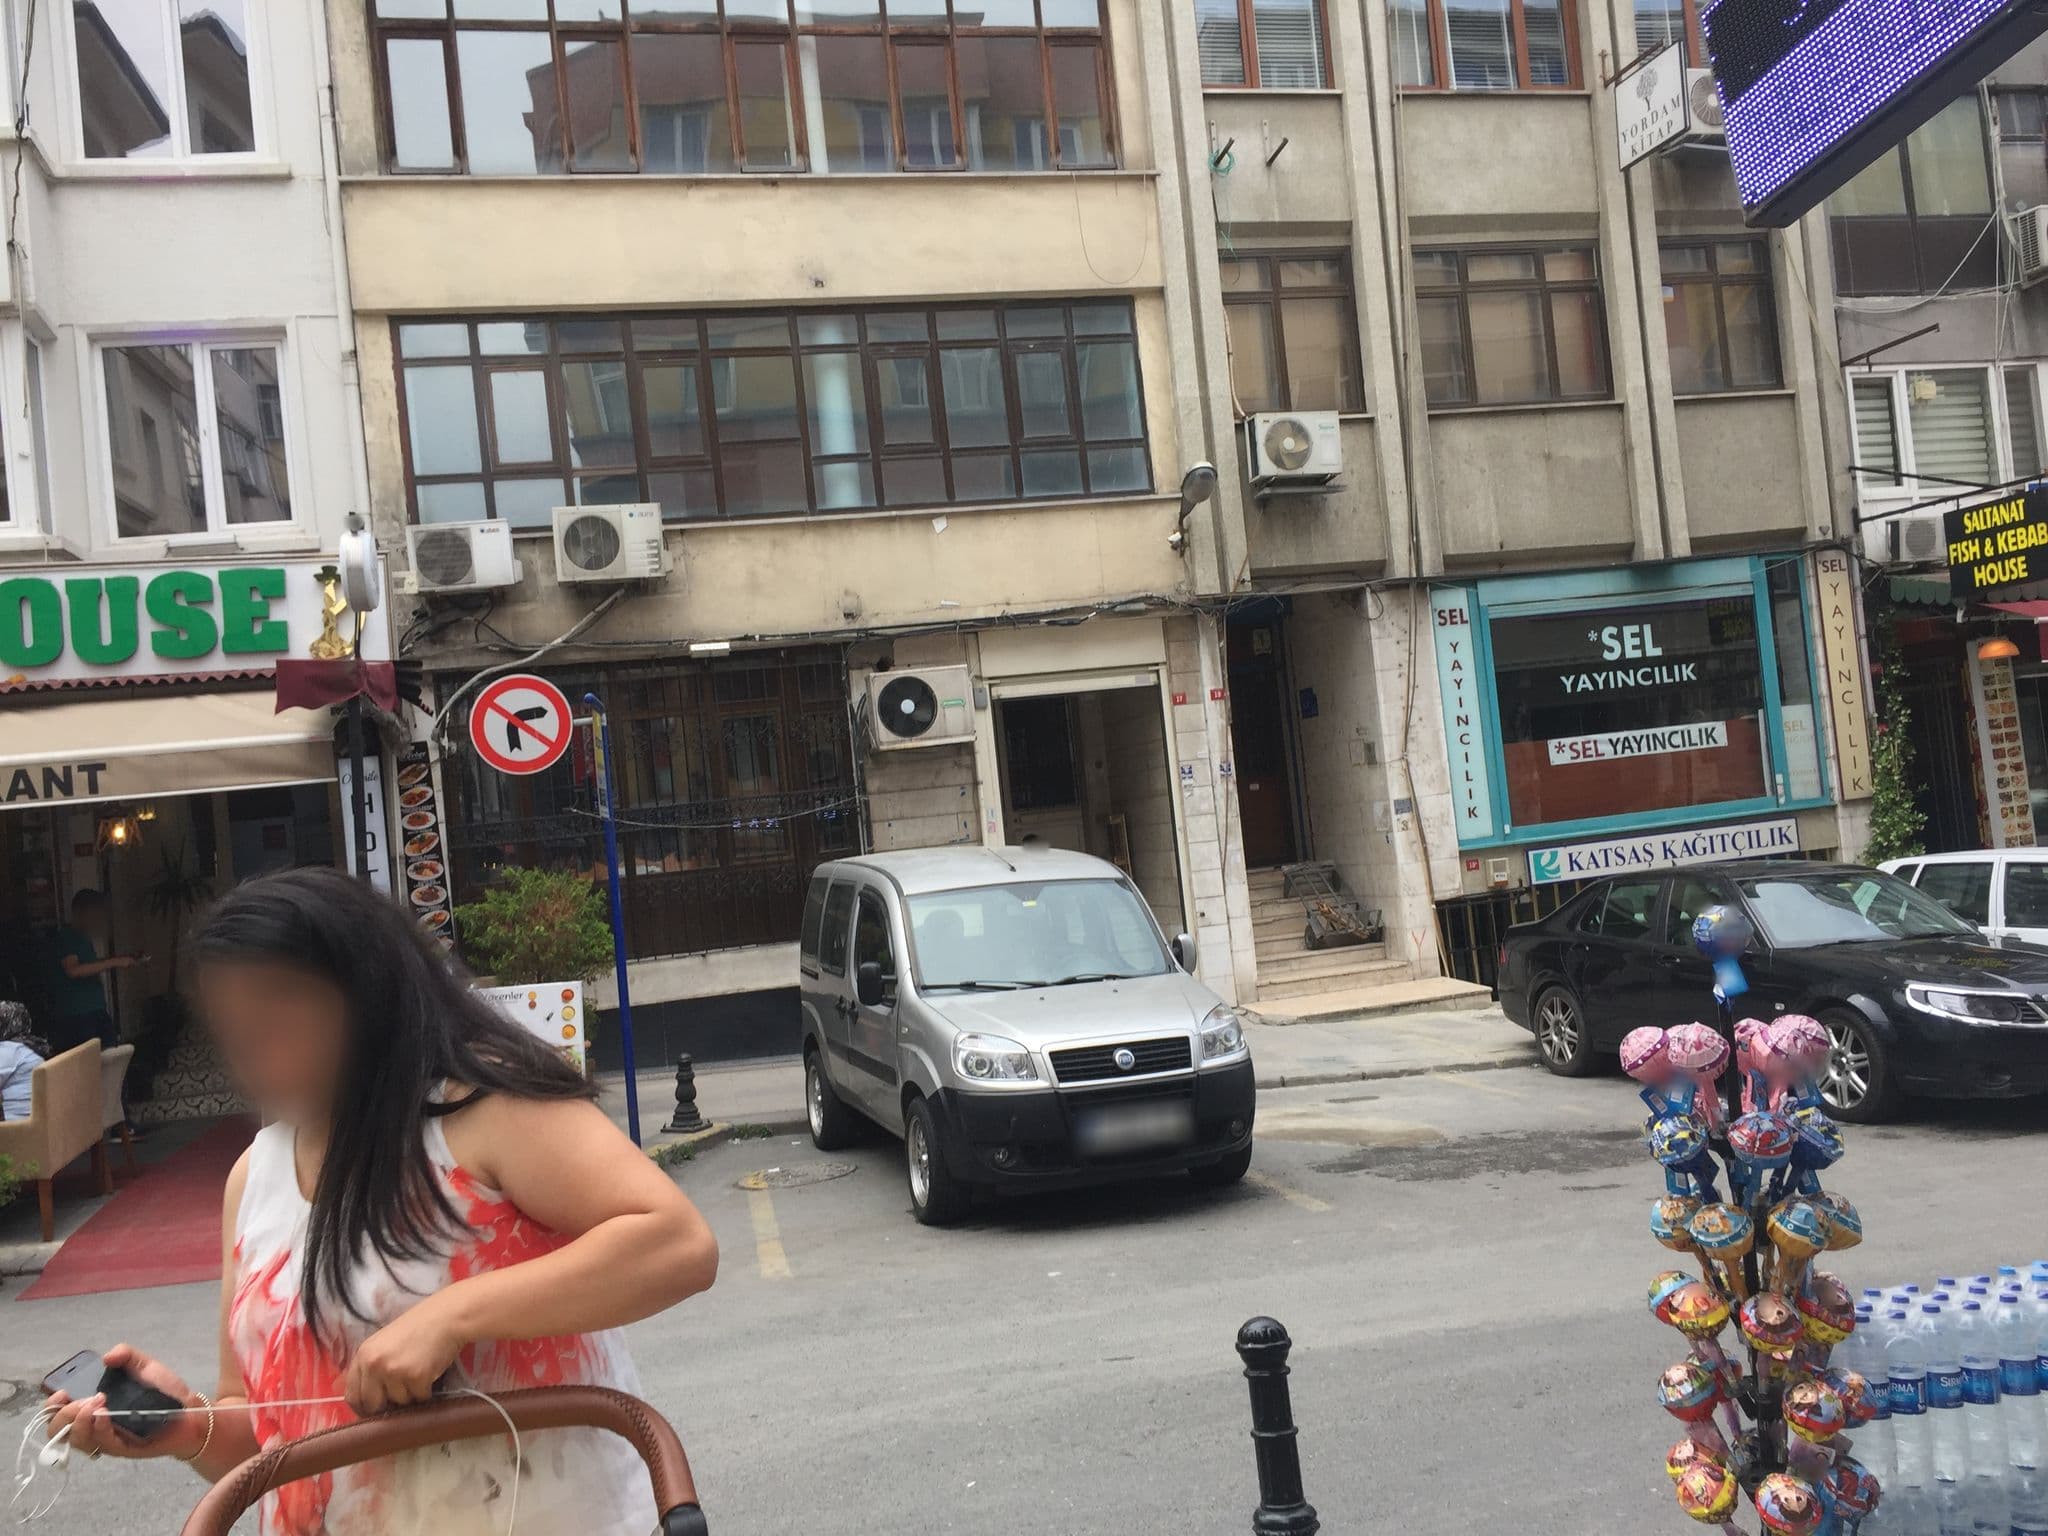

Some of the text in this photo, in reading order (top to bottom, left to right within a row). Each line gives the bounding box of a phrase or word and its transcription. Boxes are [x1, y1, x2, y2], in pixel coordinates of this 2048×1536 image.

[1621, 94, 1681, 144] YORDAM
[1963, 498, 2025, 535] SALTANAT
[1949, 522, 2048, 566] FISH & KEBAB
[1974, 555, 2028, 588] HOUSE
[0, 567, 290, 668] OUSE
[1560, 662, 1697, 694] YAYINCILIK
[1829, 582, 1864, 792] YAYINCILIK
[1449, 641, 1479, 819] YAYINCILIK
[1608, 726, 1718, 756] YAYINCILIK
[0, 763, 107, 802] ANT
[1568, 824, 1793, 873] KATSAŞ KAĞITÇILIK
